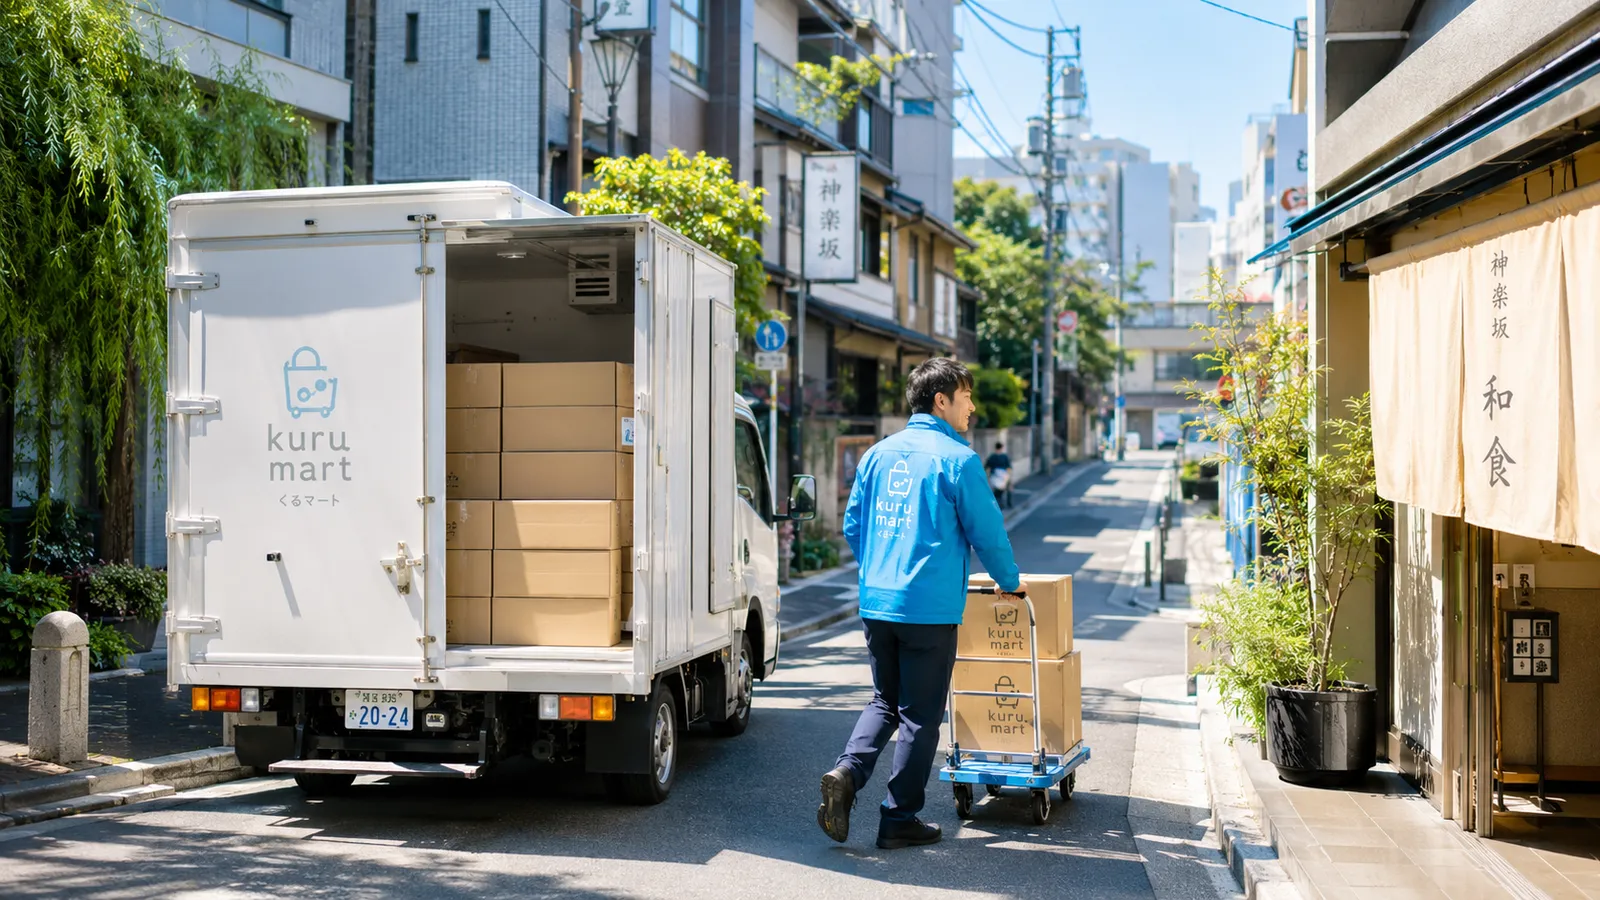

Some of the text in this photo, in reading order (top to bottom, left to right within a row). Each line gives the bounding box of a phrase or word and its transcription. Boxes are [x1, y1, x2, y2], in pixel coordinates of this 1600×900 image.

[818, 178, 842, 260] 神楽坂
[1482, 250, 1516, 488] 神楽坂 和食
[267, 423, 351, 452] kuru
[269, 456, 352, 481] mart
[279, 493, 340, 507] くるマート
[875, 514, 912, 529] mart
[990, 640, 1024, 651] mart
[359, 705, 409, 726] 20-24
[990, 724, 1025, 735] mart
